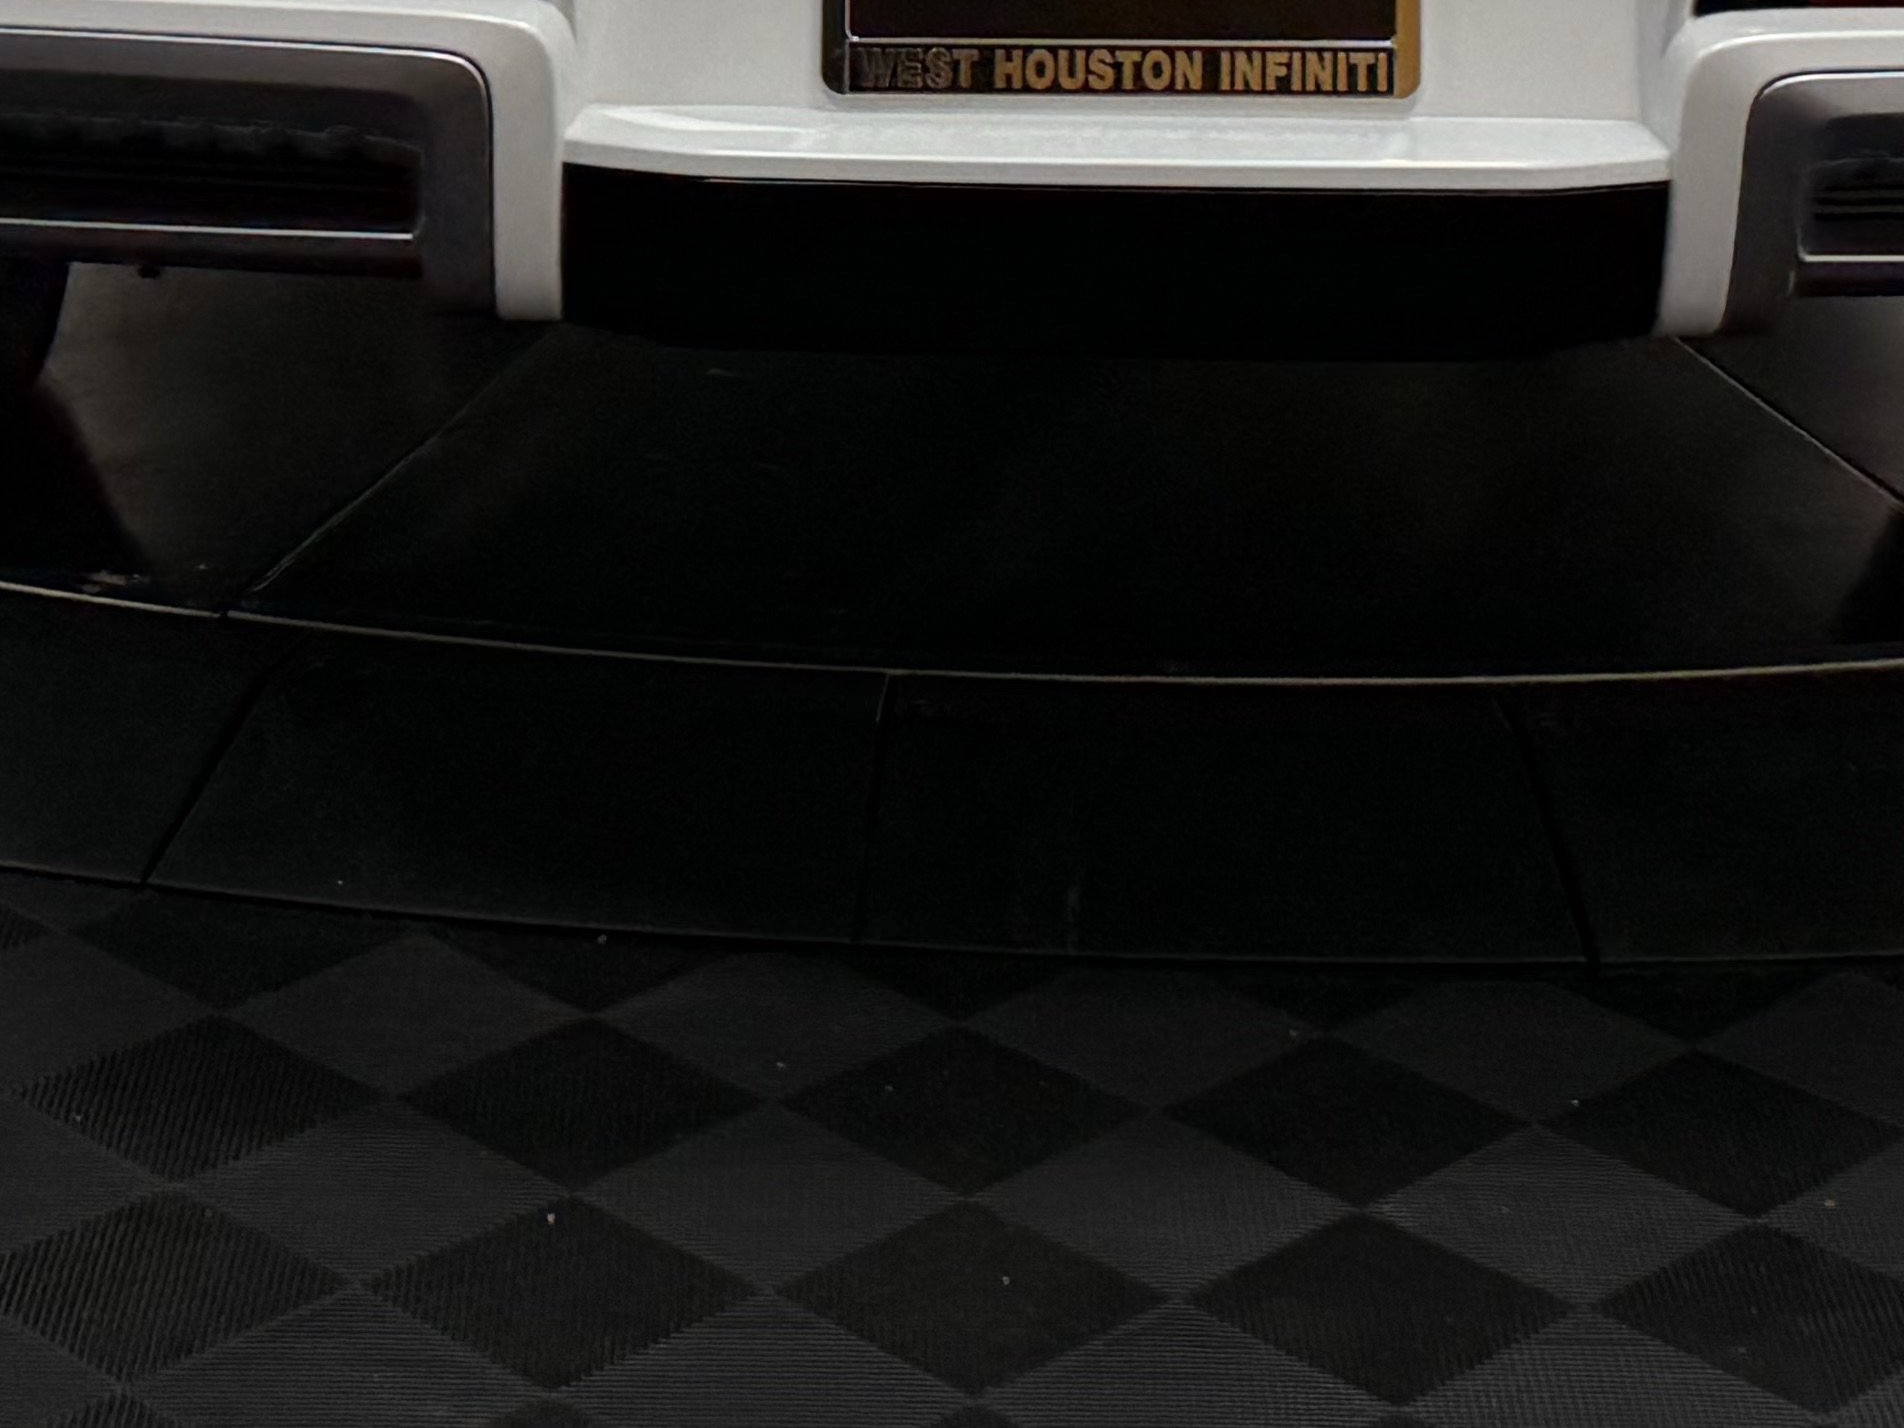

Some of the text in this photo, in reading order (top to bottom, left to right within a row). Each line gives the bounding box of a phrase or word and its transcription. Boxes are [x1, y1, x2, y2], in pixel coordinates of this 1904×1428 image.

[857, 46, 1391, 94] WEST HOUSTON INFINITI
